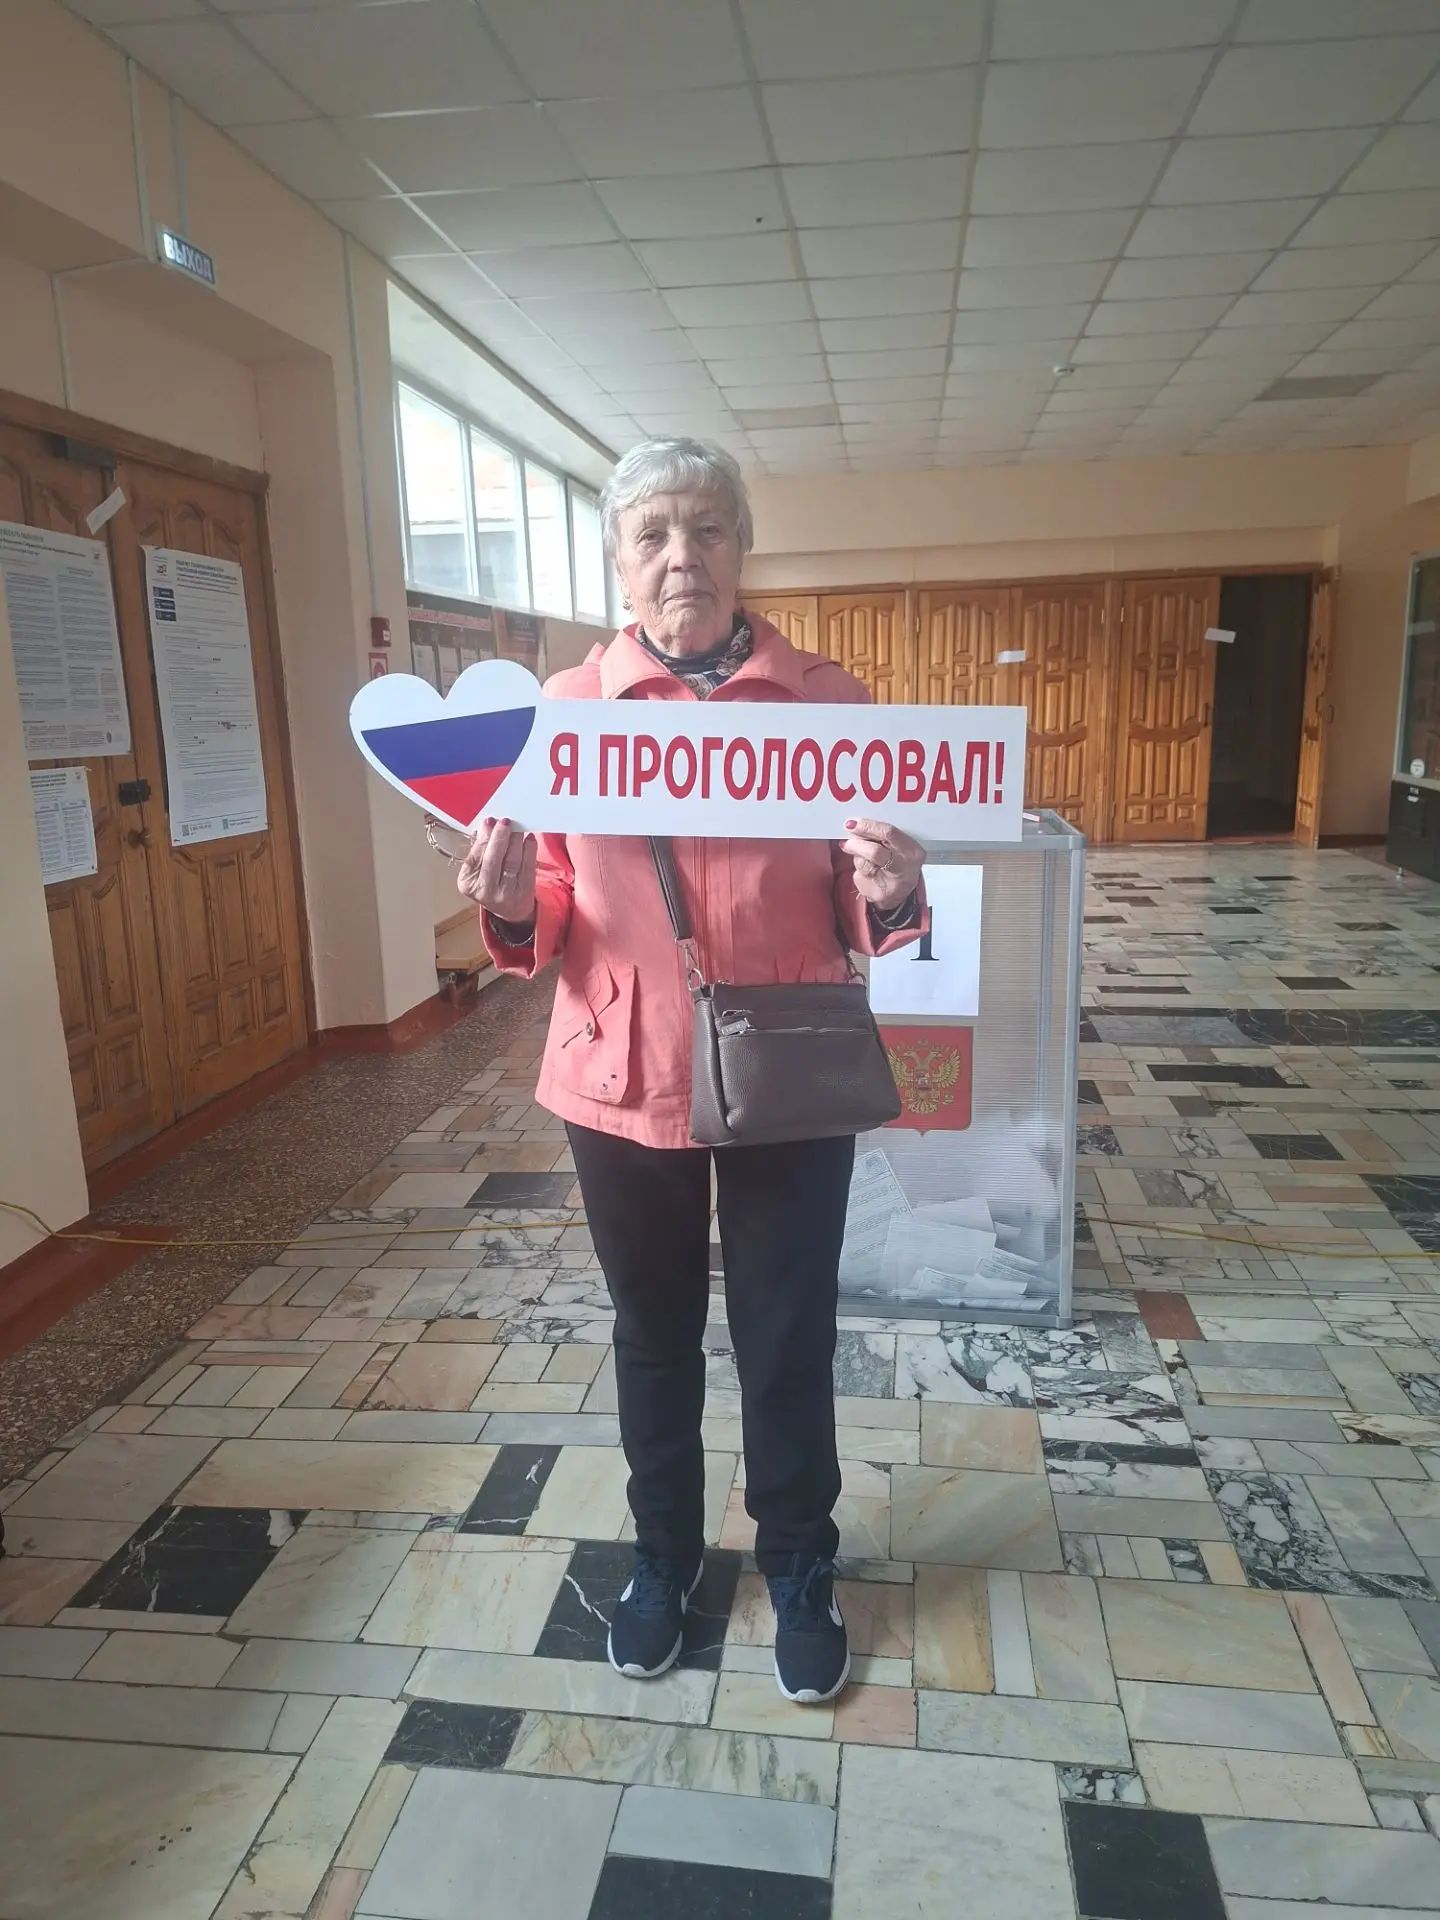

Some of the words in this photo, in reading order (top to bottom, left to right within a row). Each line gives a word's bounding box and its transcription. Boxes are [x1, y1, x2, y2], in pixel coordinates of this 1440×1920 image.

[164, 233, 212, 280] ВЫХОД
[549, 732, 579, 796] Я
[599, 734, 1005, 804] ПРОГОЛОСОВАЛ!
